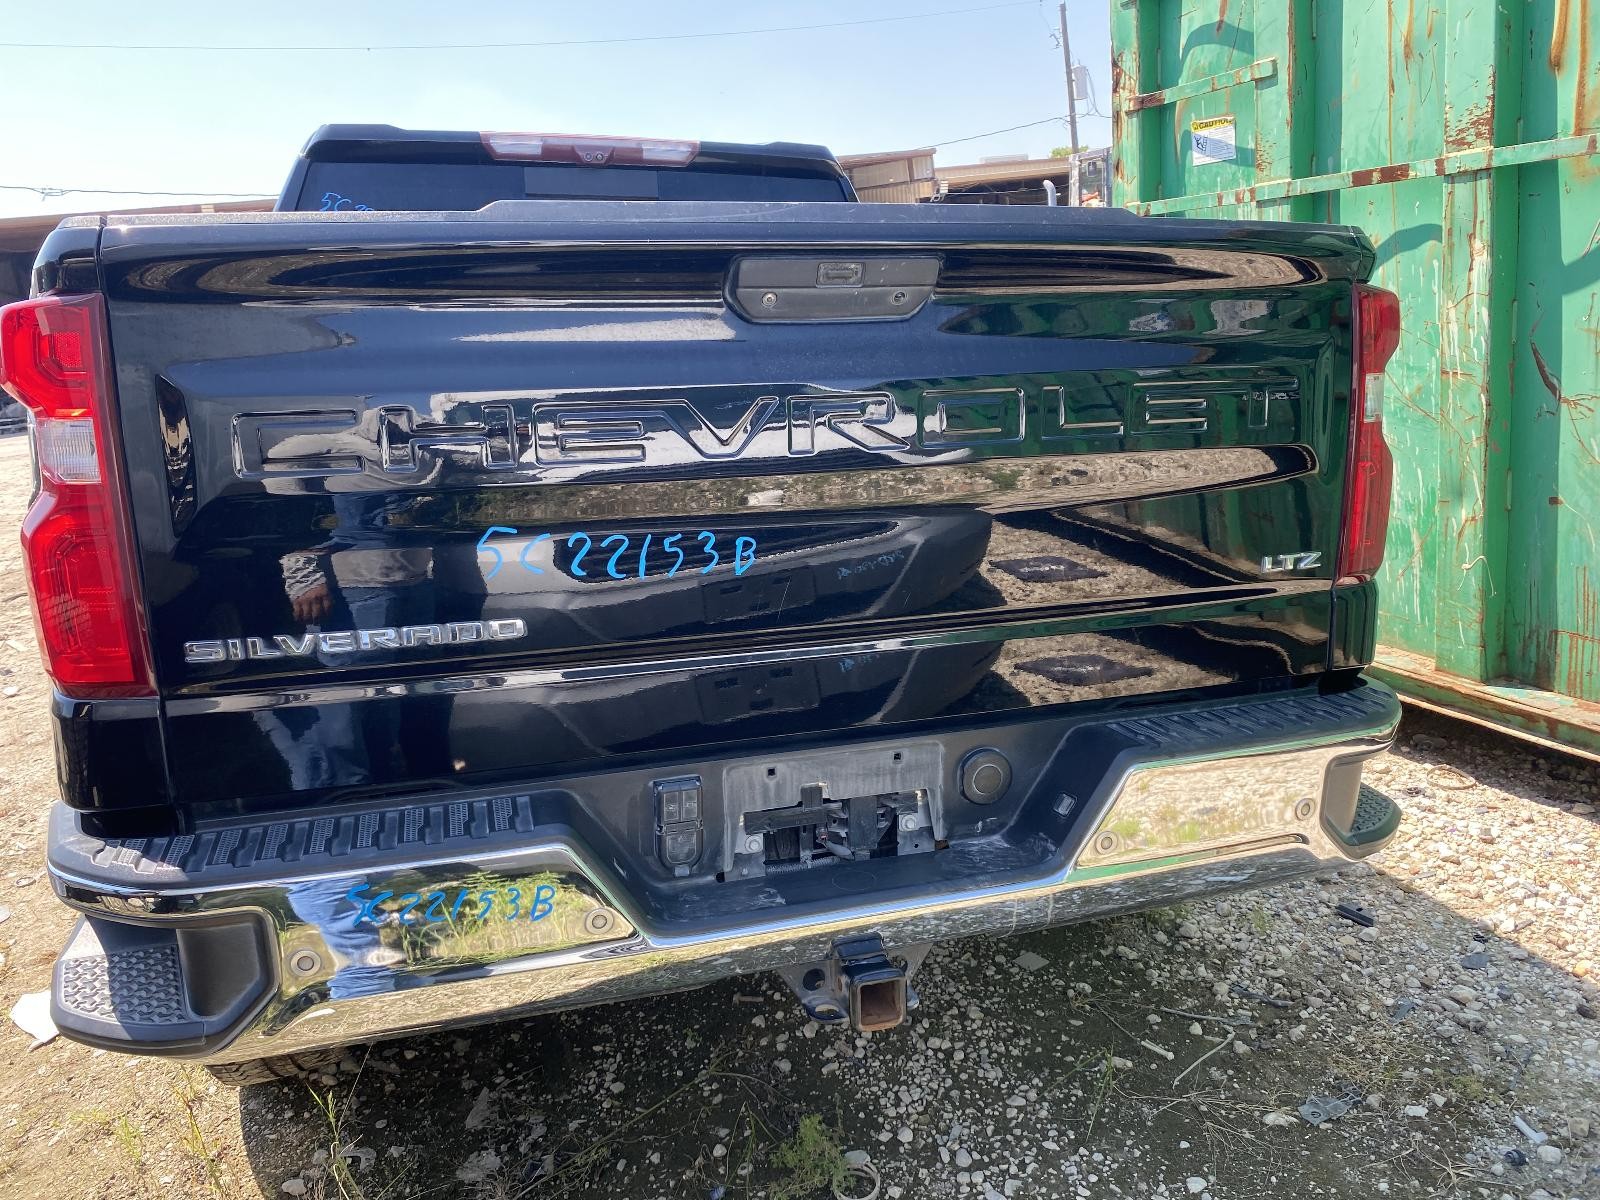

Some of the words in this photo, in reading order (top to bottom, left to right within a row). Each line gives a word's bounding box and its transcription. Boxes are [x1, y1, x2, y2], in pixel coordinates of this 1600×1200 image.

[231, 376, 1300, 479] CHEVROLET
[1260, 551, 1322, 573] LTZ
[184, 618, 526, 664] SILVERADO
